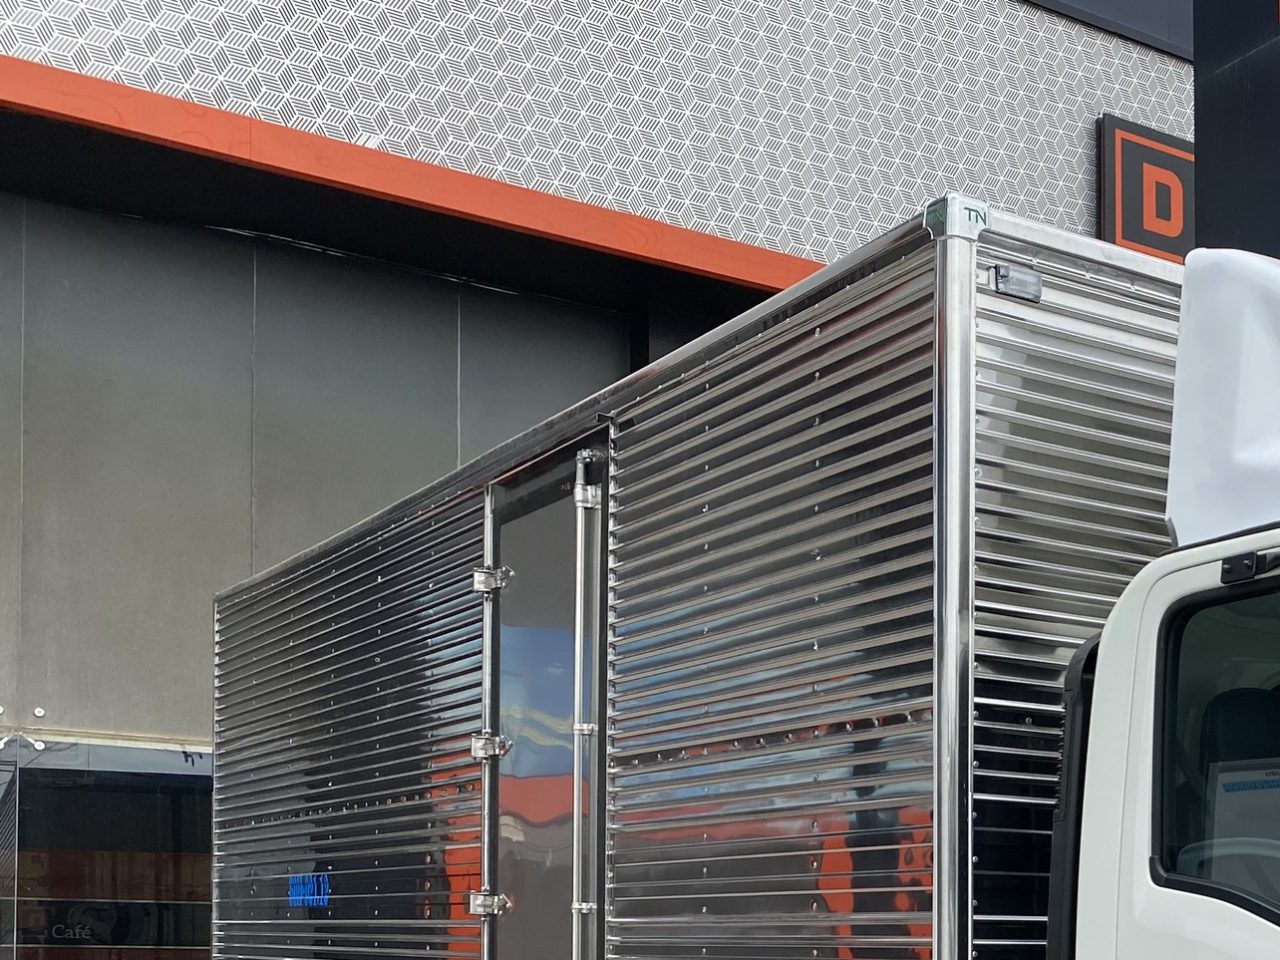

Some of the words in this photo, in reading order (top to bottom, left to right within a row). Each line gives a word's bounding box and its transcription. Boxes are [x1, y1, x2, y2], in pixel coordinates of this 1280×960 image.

[1142, 162, 1184, 238] D
[963, 206, 987, 226] TN
[52, 924, 92, 939] Café
